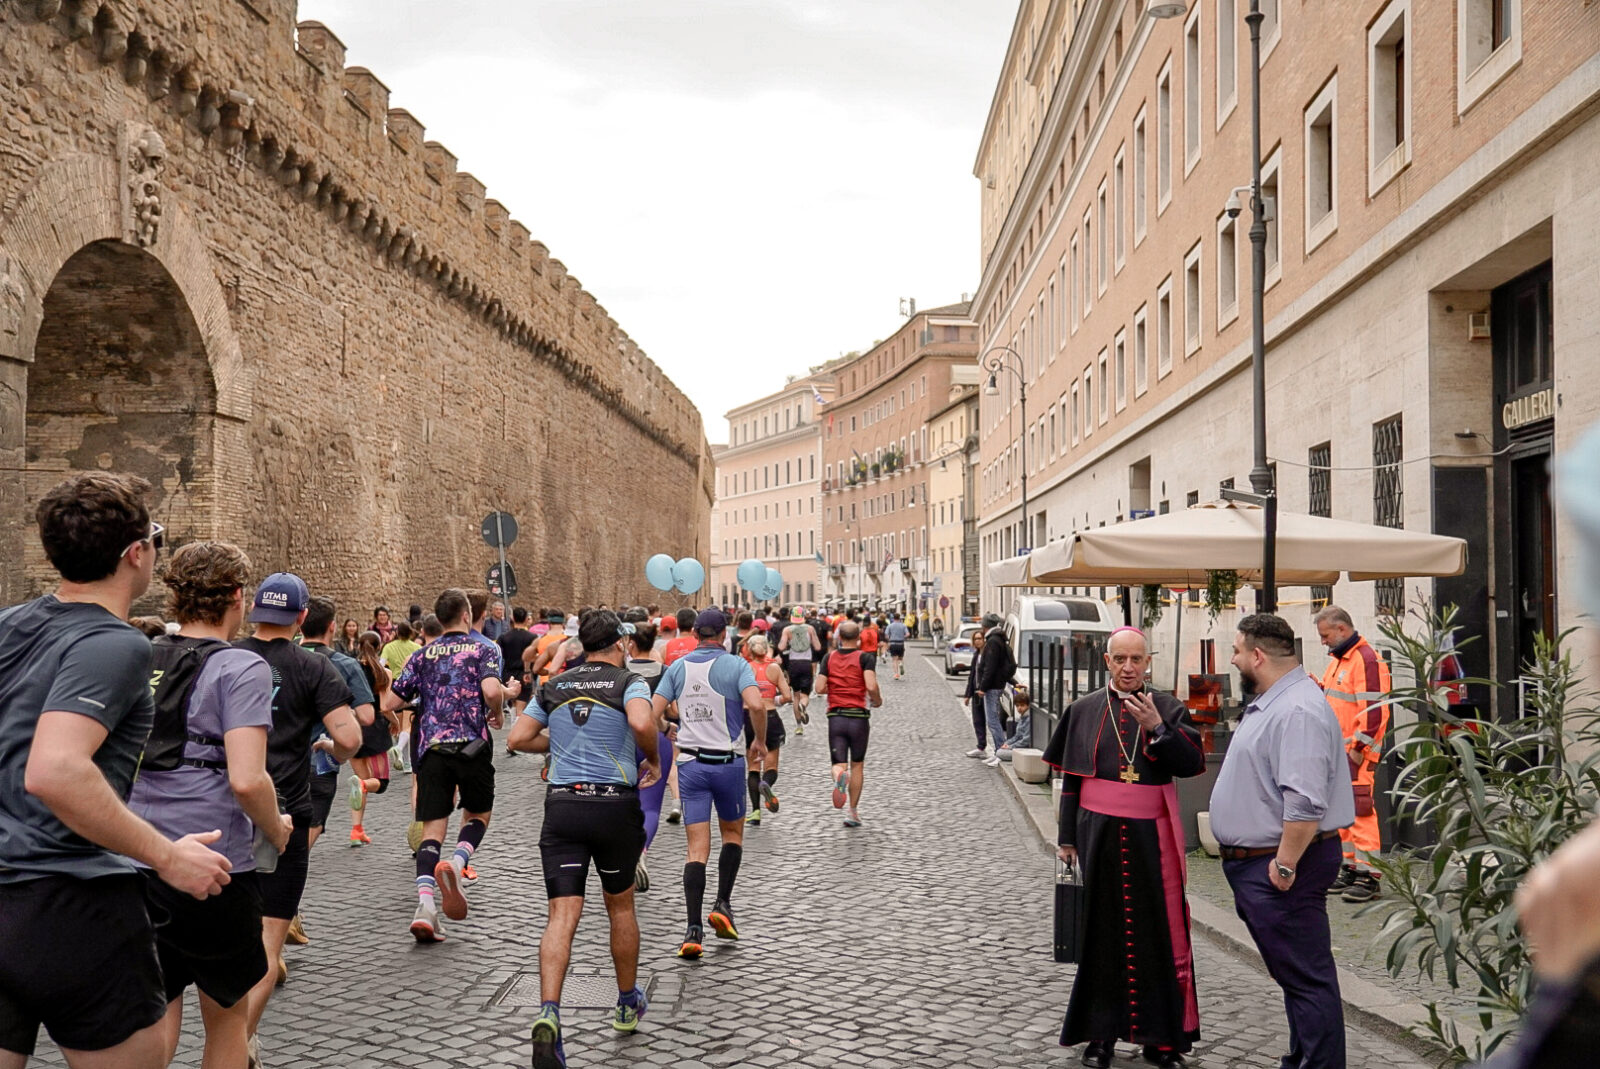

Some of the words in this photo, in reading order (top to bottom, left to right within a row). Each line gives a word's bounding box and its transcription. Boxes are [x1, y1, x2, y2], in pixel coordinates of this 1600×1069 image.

[1503, 388, 1555, 429] GALLERI
[263, 591, 288, 601] UTMB
[425, 643, 477, 660] Corona
[556, 680, 615, 690] FUNRUNNERS
